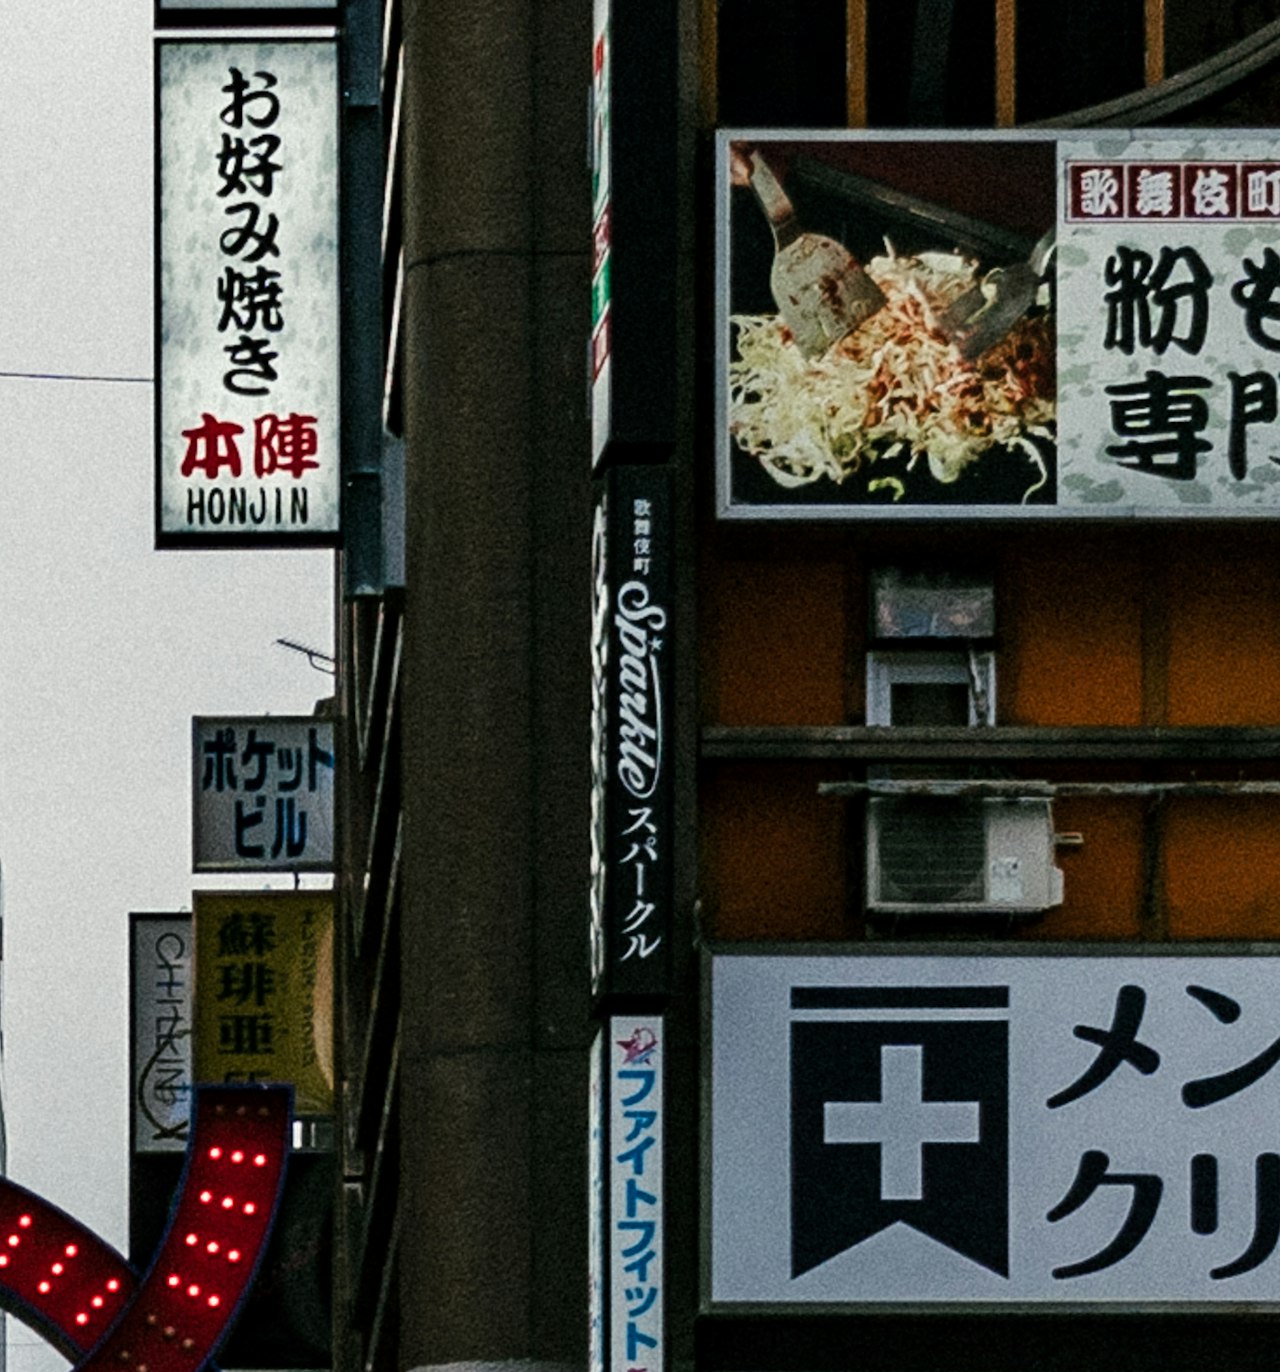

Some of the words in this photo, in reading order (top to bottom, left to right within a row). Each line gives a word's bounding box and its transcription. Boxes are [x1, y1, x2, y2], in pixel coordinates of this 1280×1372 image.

[216, 67, 284, 396] お好み焼き
[180, 413, 319, 479] 本陣
[187, 487, 308, 525] HONJIN
[202, 728, 336, 793] ポケット
[235, 799, 307, 859] ビル
[620, 808, 661, 961] スパークル
[1045, 984, 1280, 1110] メン
[615, 1069, 659, 1362] ファイトフィット
[1046, 1150, 1280, 1280] クリ
